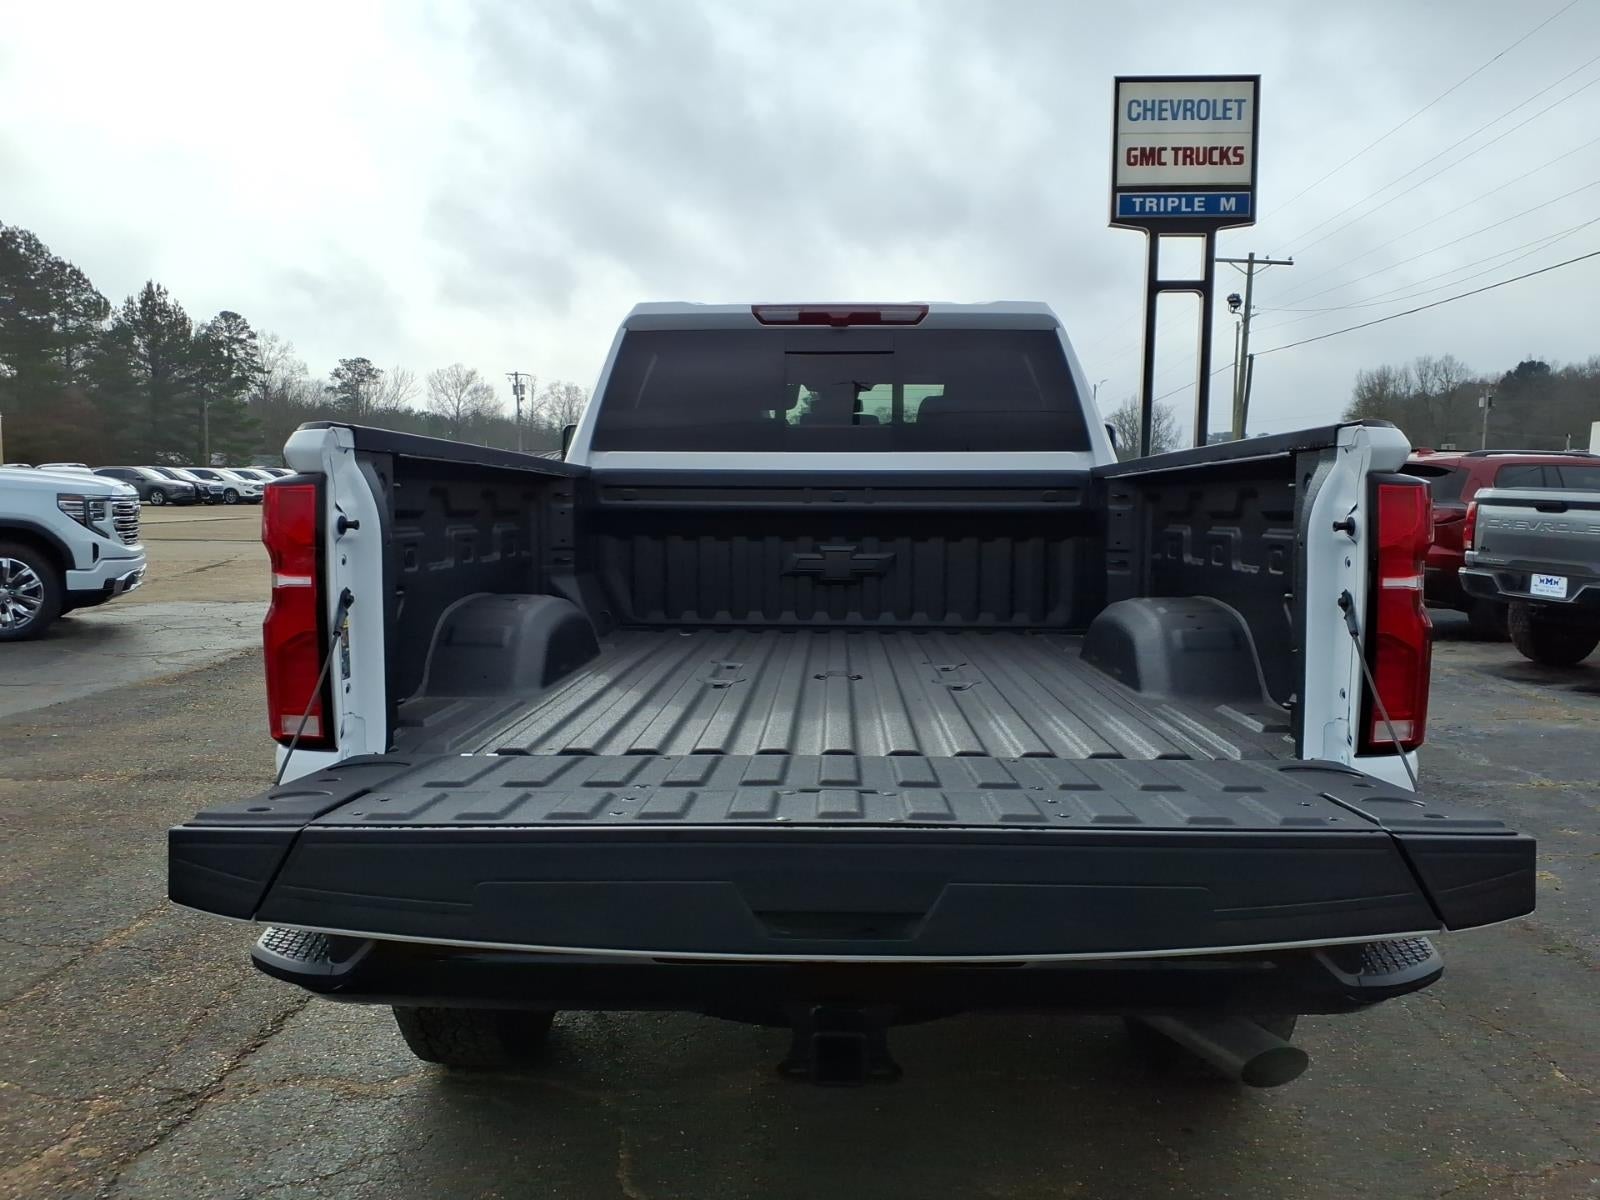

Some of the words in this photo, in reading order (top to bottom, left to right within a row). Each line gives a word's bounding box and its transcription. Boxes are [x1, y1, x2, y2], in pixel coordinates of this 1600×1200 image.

[1127, 98, 1246, 121] CHEVROLET
[1126, 146, 1167, 166] GMC
[1171, 146, 1245, 166] TRUCKS
[1132, 197, 1206, 212] TRIPLE
[1220, 197, 1236, 211] M
